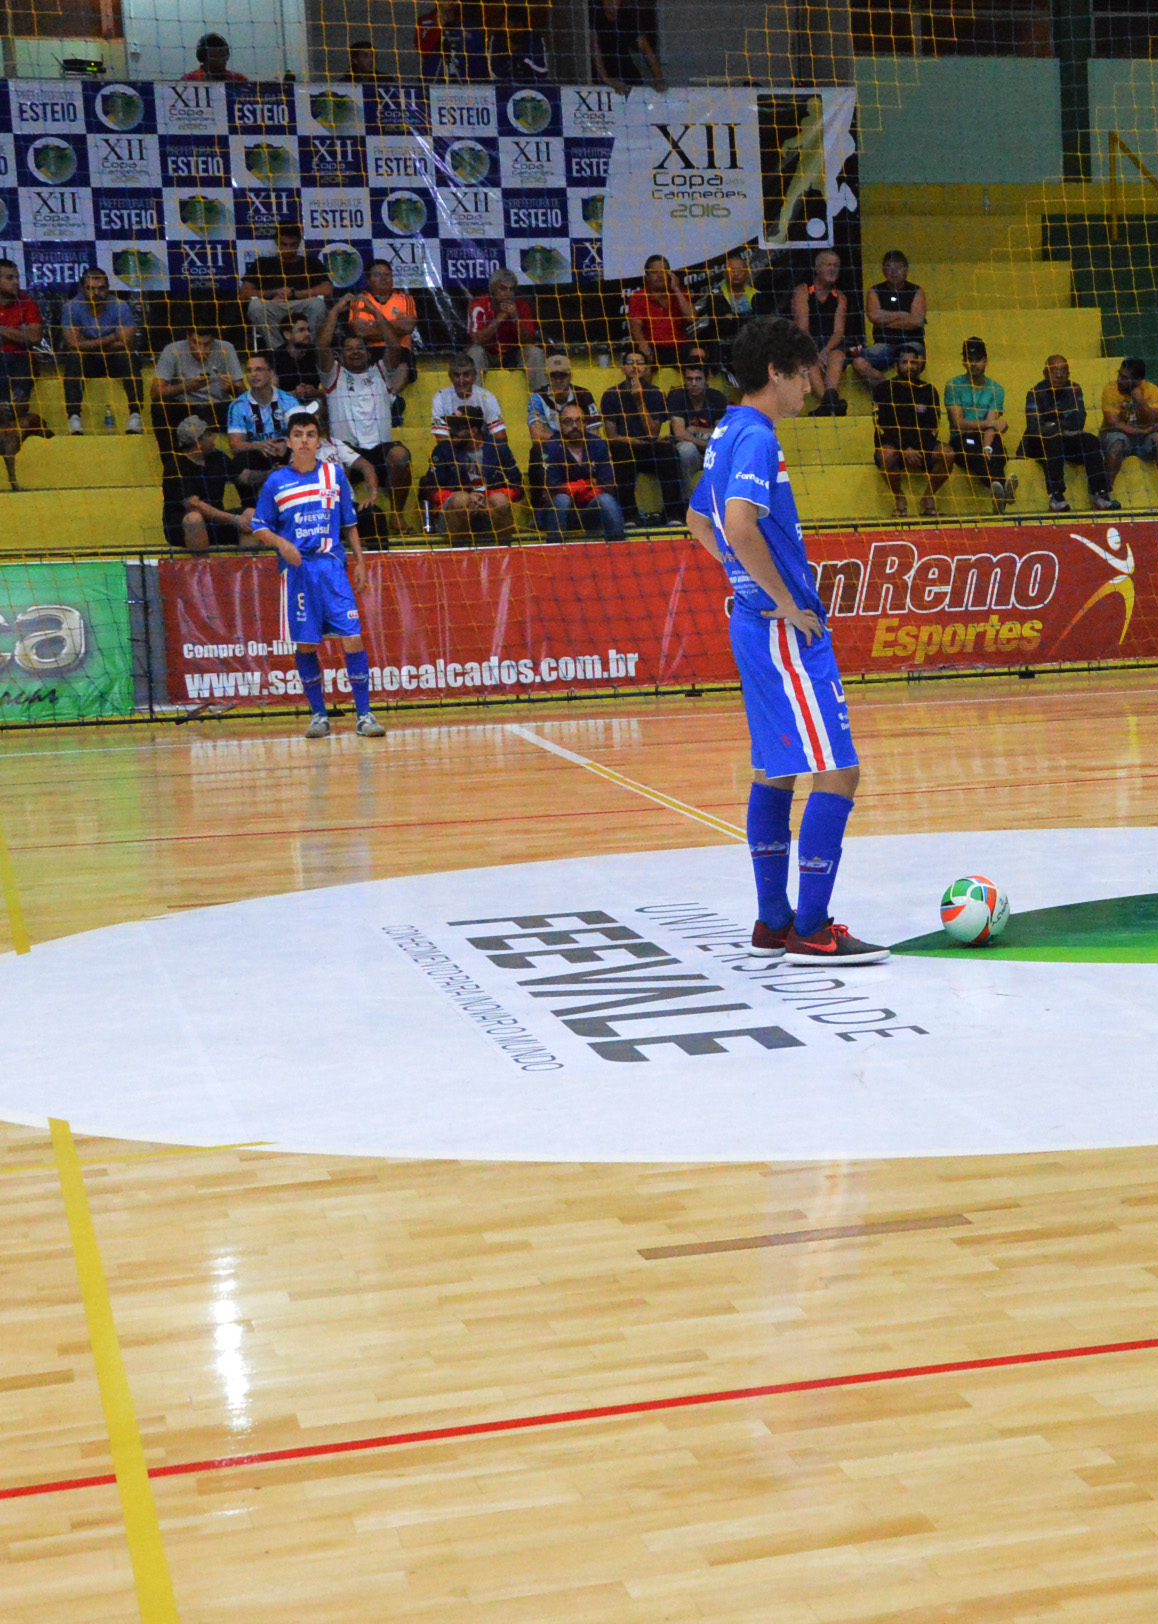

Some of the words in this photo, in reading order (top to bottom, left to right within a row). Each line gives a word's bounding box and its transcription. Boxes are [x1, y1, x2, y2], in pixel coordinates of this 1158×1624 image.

[168, 86, 214, 108] XII
[377, 88, 417, 110] XII
[574, 91, 614, 112] XII
[19, 102, 77, 122] ESTEIO
[234, 104, 289, 124] ESTEIO
[437, 106, 490, 126] ESTEIO
[100, 138, 146, 160] XII
[312, 140, 355, 162] XII
[512, 141, 552, 163] XII
[650, 123, 744, 170] XII
[167, 156, 223, 176] ESTEIO
[652, 171, 724, 189] Copa
[33, 191, 79, 214] XII
[246, 191, 290, 214] XII
[450, 191, 490, 213] XII
[670, 203, 732, 218] 2016
[100, 209, 156, 229] ESTEIO
[310, 209, 364, 229] ESTEIO
[510, 209, 562, 228] ESTEIO
[182, 244, 225, 266] XII
[183, 642, 245, 659] Compre
[870, 615, 1043, 664] Esportes
[492, 1034, 565, 1071] MUNDO
